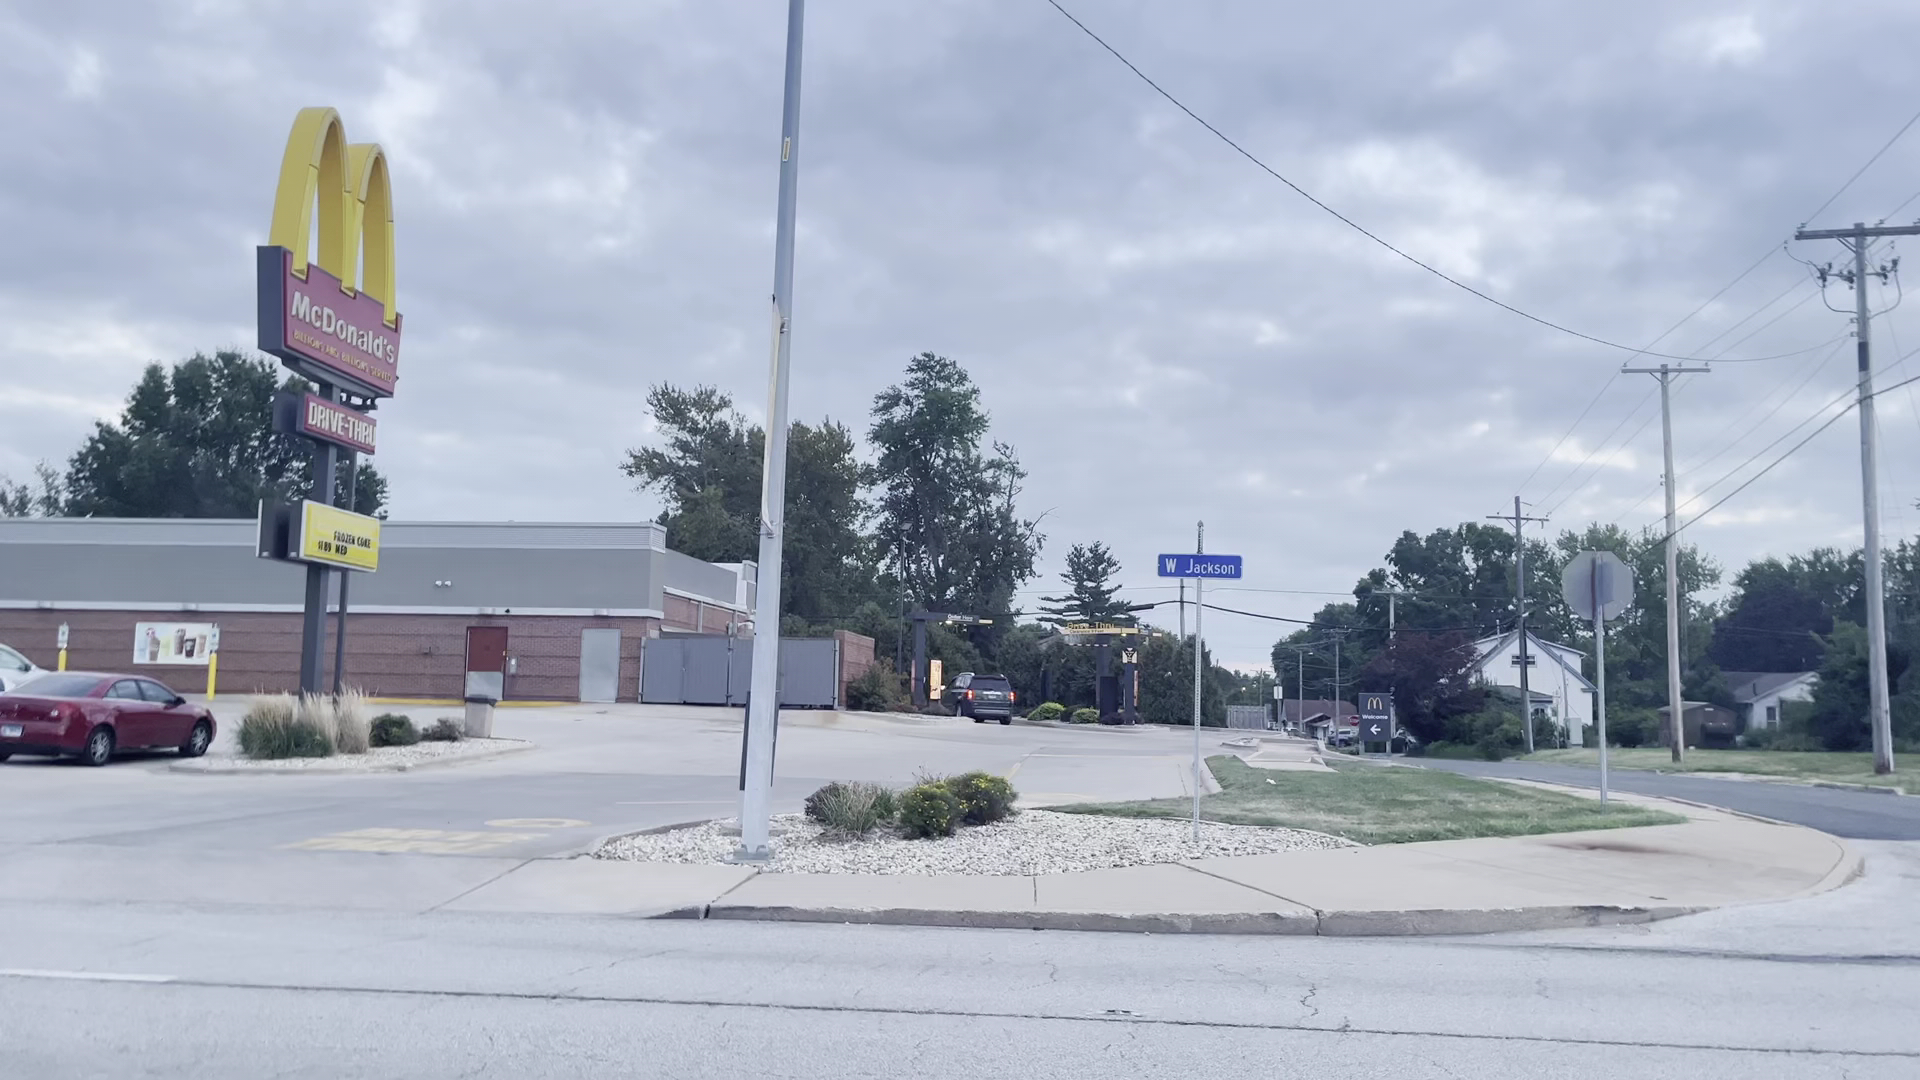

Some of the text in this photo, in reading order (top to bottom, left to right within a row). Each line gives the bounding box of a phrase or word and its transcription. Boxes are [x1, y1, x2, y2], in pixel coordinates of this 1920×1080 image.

[291, 291, 395, 364] McDonald's
[341, 351, 369, 373] BILLIONS
[370, 366, 393, 383] SERVED
[308, 401, 376, 446] DRIVE-THRU
[333, 530, 371, 549] FROZEN COKE
[335, 543, 348, 556] MED
[1165, 558, 1235, 574] W Jackson
